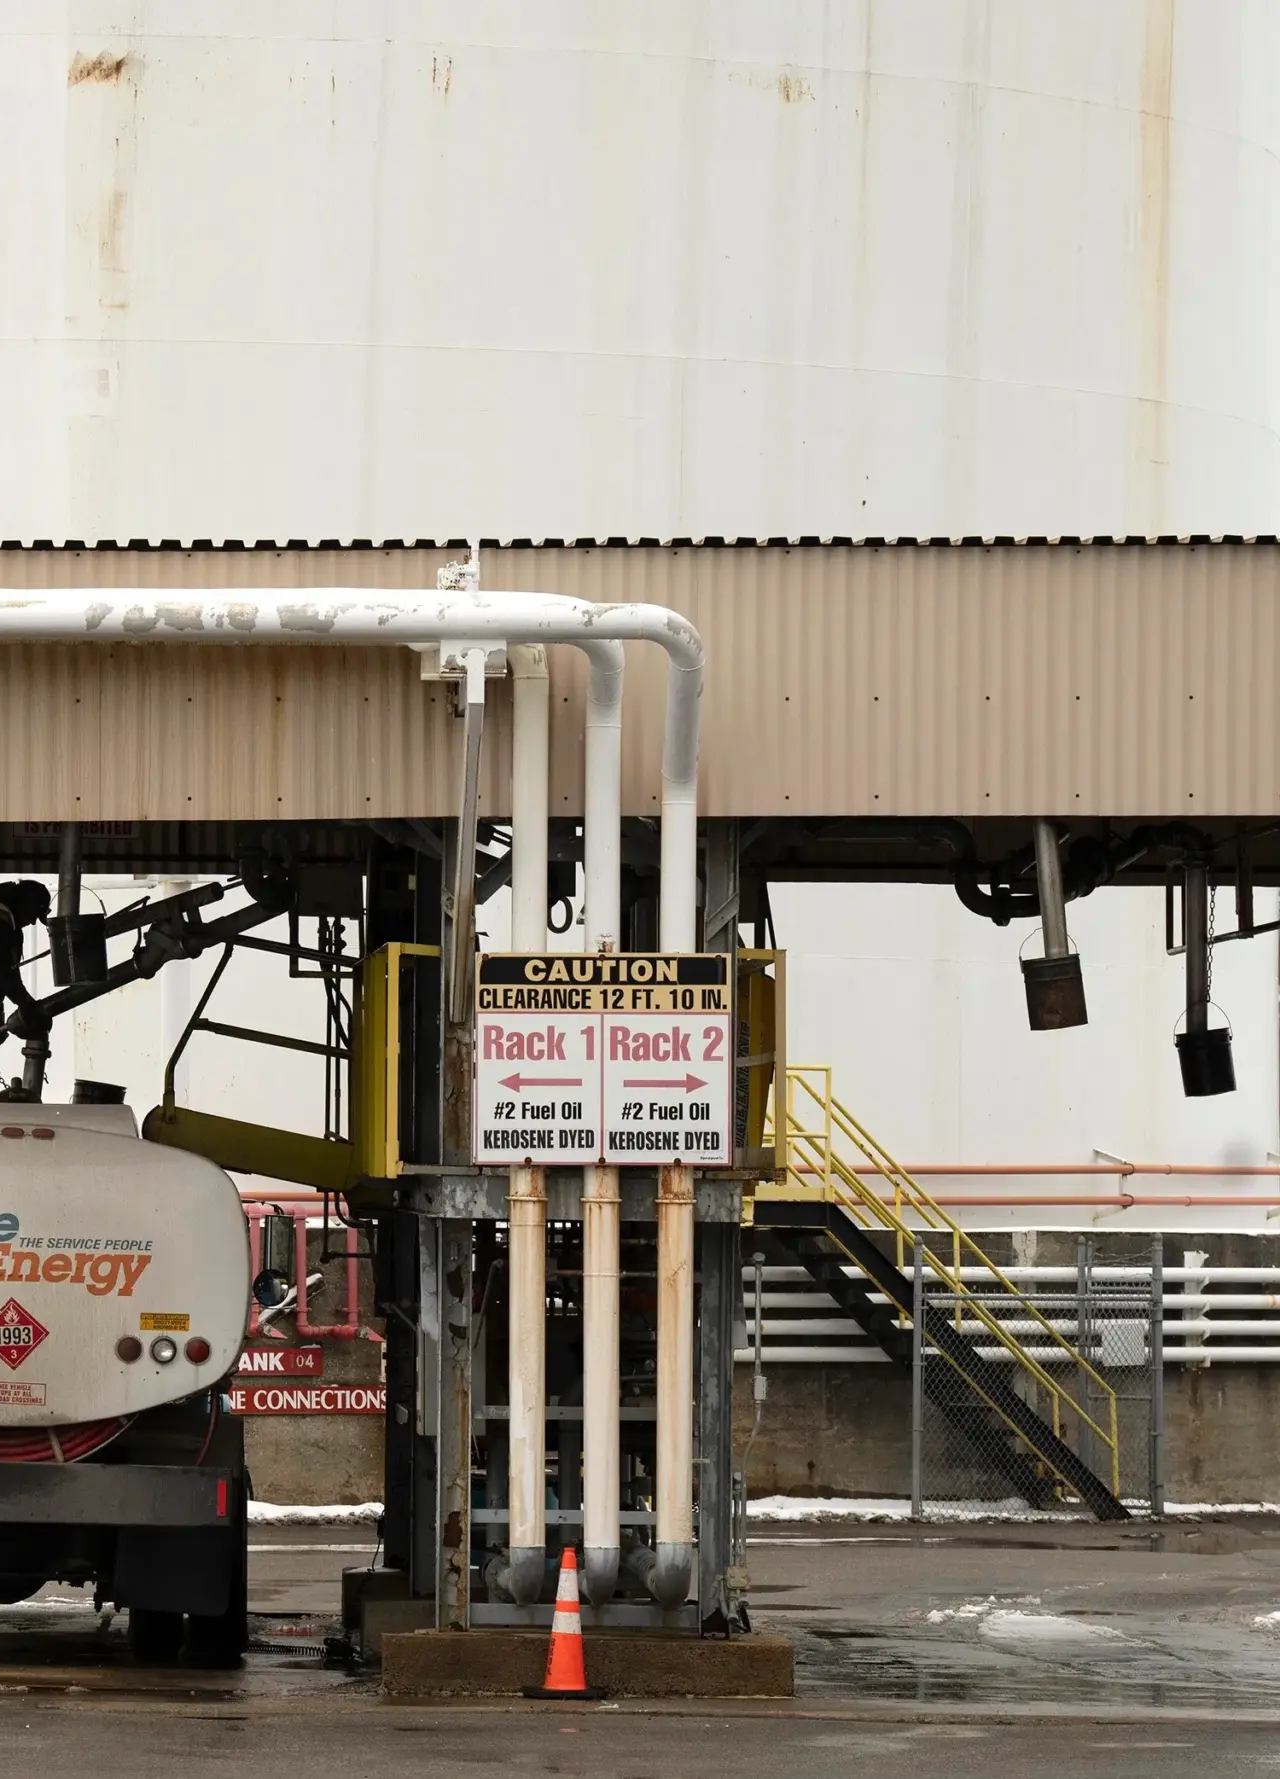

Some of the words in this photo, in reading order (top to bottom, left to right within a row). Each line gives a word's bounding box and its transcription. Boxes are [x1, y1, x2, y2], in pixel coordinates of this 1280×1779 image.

[524, 958, 679, 983] CAUTION
[479, 988, 592, 1010] CLEARANCE
[599, 988, 624, 1010] 12
[632, 988, 660, 1010] FT.
[670, 988, 694, 1010] 10
[702, 988, 728, 1010] IN.
[483, 1024, 566, 1061] Rack
[580, 1025, 595, 1061] 1
[609, 1025, 692, 1062] Rack
[702, 1025, 724, 1062] 2
[494, 1102, 516, 1120] #2
[521, 1101, 556, 1120] Fuel
[561, 1101, 582, 1120] Oil
[621, 1103, 643, 1121] #2
[649, 1102, 684, 1121] Fuel
[689, 1103, 710, 1121] Oil
[483, 1129, 554, 1150] KEROSENE
[559, 1129, 595, 1149] DYED
[609, 1131, 679, 1151] KEROSENE
[685, 1131, 720, 1151] DYED
[19, 1237, 45, 1249] THE
[47, 1237, 102, 1250] SERVICE
[104, 1239, 153, 1251] PEOPLE
[10, 1349, 18, 1360] 3
[238, 1352, 284, 1371] ANK
[11, 1396, 43, 1404] CROSSINGS
